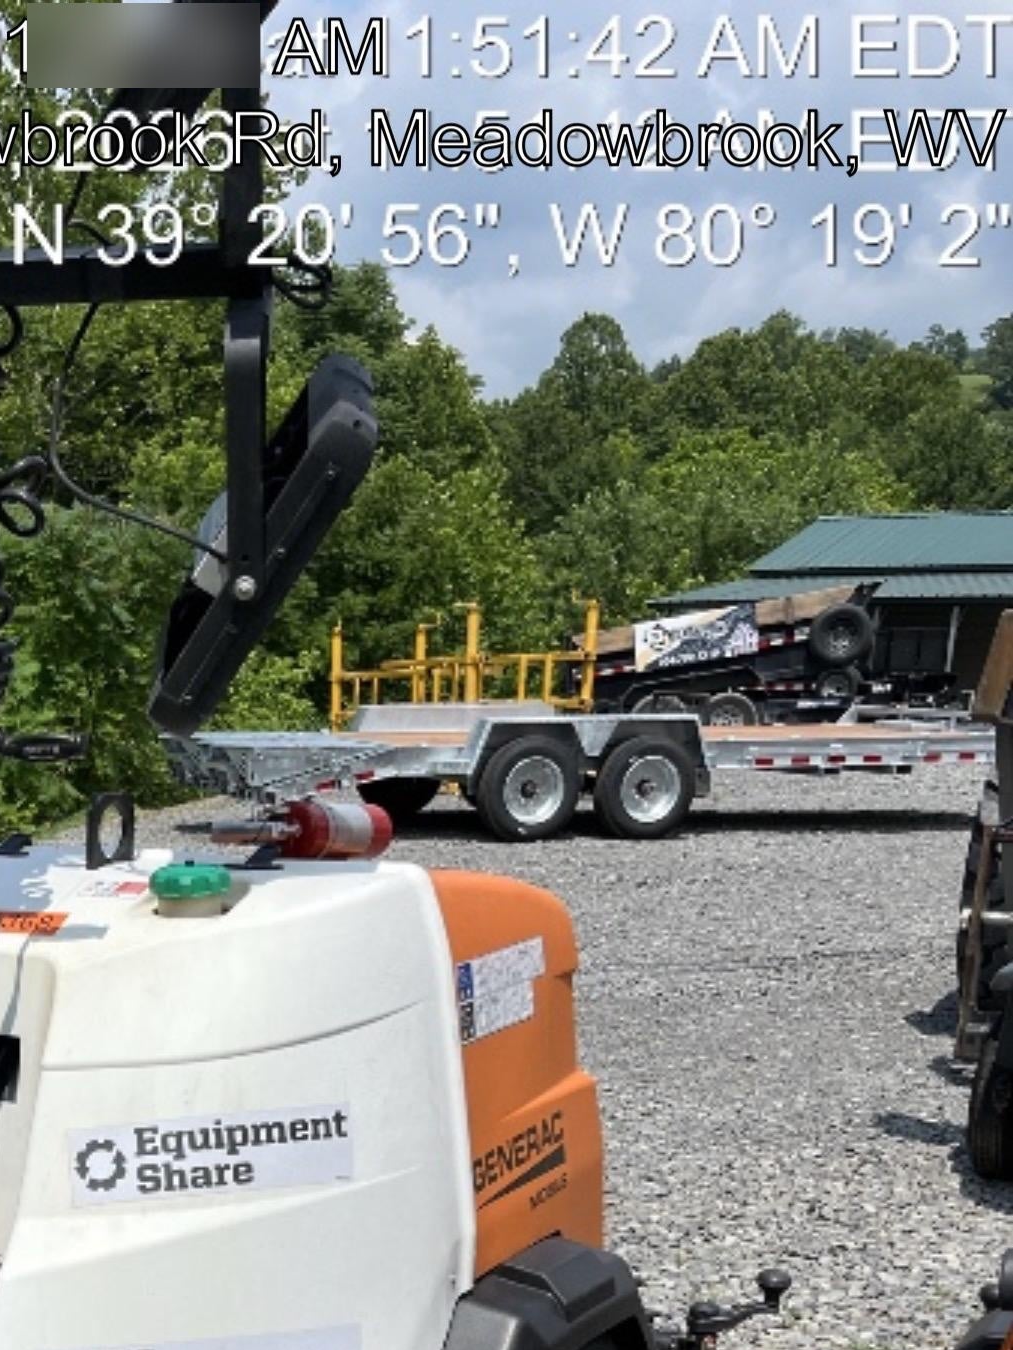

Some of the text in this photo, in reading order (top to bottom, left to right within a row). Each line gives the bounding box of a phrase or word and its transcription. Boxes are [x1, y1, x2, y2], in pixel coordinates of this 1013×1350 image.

[134, 1110, 348, 1158] Equipment
[472, 1109, 566, 1193] GENERAC
[136, 1160, 255, 1195] Share
